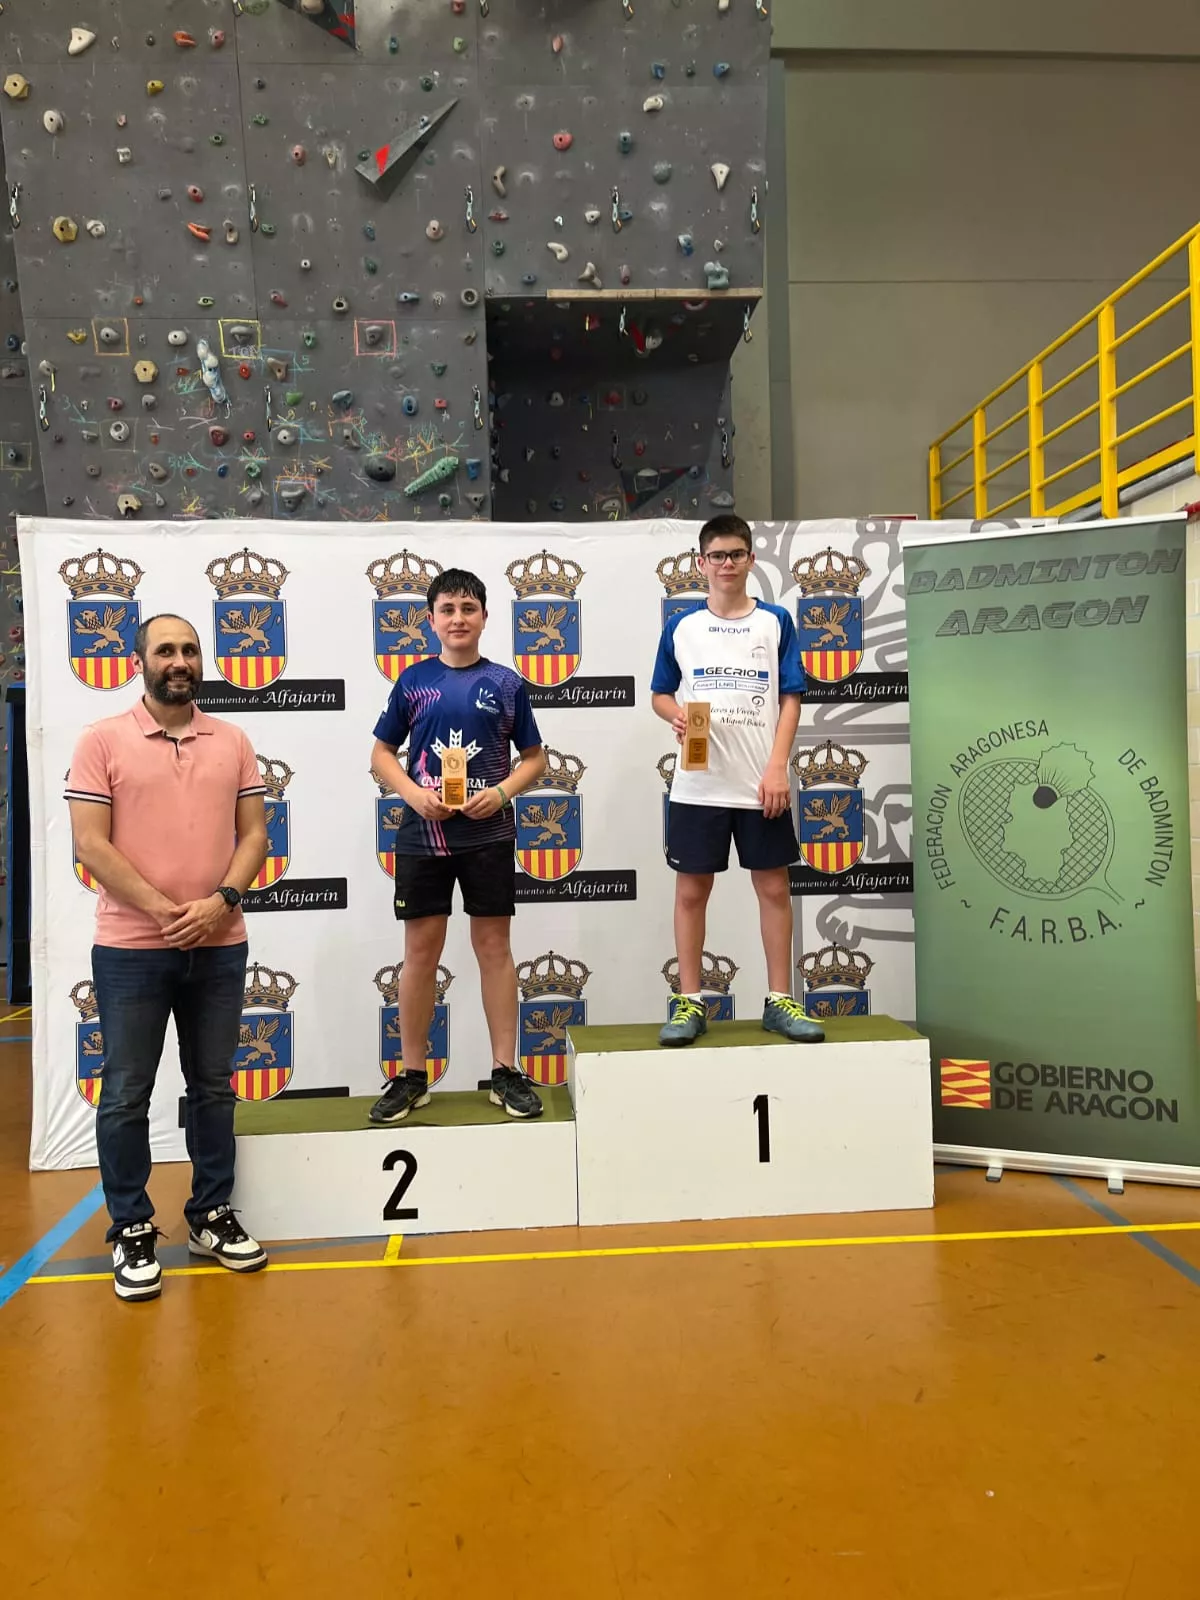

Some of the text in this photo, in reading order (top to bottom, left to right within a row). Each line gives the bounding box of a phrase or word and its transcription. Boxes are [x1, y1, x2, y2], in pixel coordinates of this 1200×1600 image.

[906, 548, 1184, 595] BADMINTON
[935, 595, 1150, 637] ARAGON
[708, 626, 750, 634] GIVOVA
[705, 666, 757, 678] GECRIO
[544, 691, 555, 701] de
[827, 687, 837, 696] de
[248, 694, 260, 704] de
[926, 719, 1174, 890] FEDERACION ARAGONESA DE BADMINTON
[829, 879, 839, 888] de
[546, 886, 557, 895] de
[251, 895, 261, 905] de
[994, 1061, 1154, 1094] GOBIERNO
[995, 1088, 1179, 1123] DE ARAGON
[753, 1094, 771, 1163] 1
[382, 1149, 419, 1221] 2
